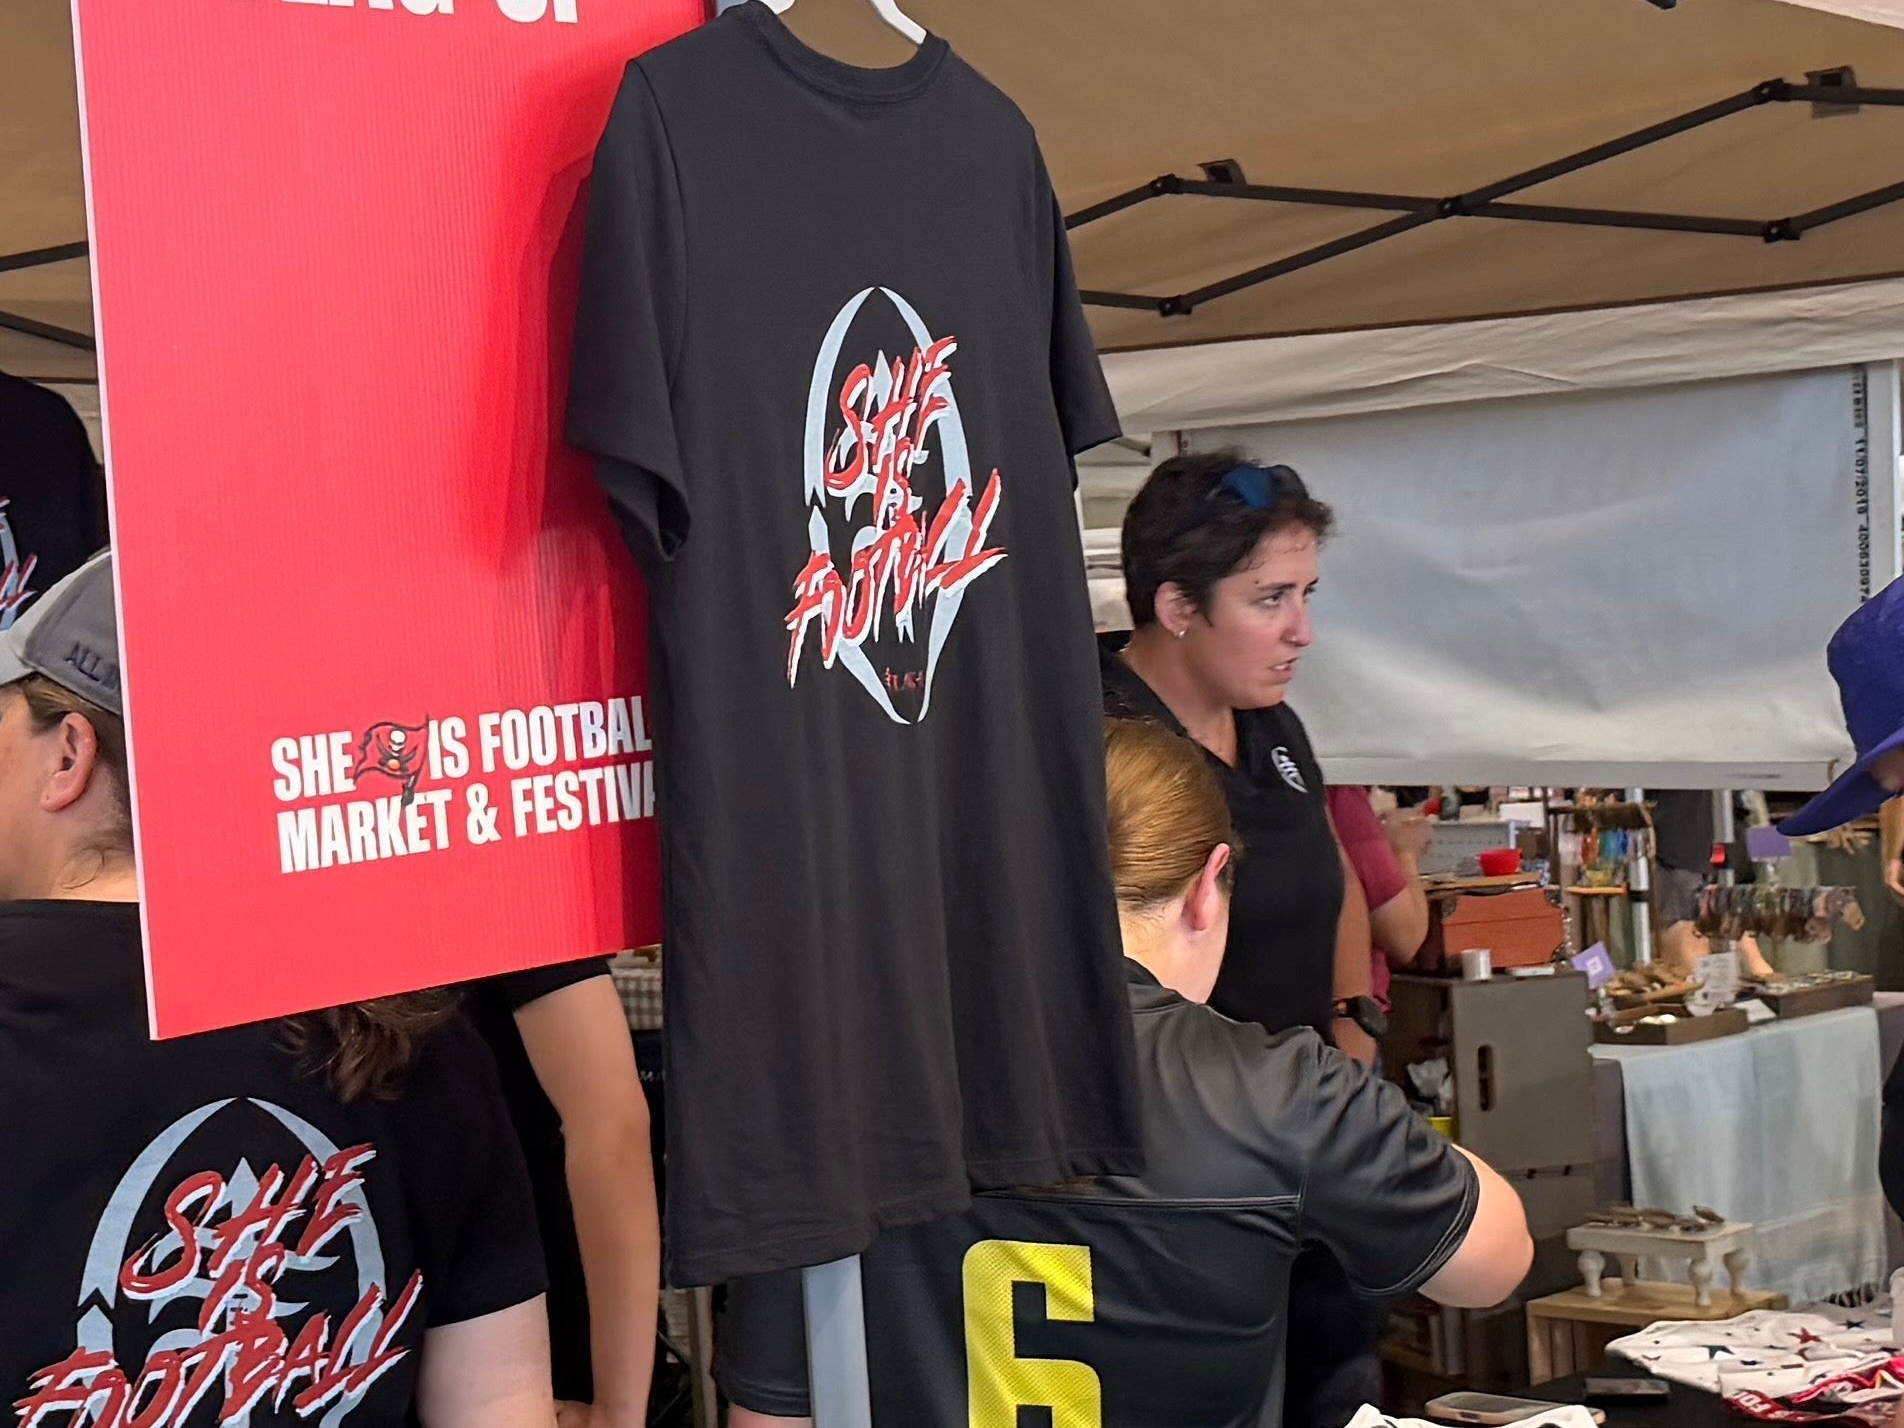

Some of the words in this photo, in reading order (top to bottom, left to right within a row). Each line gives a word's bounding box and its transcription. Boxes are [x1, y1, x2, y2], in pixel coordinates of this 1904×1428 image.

[825, 335, 958, 498] SHE
[271, 730, 356, 802] SHE
[428, 716, 470, 780] IS
[479, 695, 653, 773] FOOTBAL
[276, 788, 453, 874] MARKET
[466, 783, 502, 845] &
[119, 1142, 378, 1301] SHE
[198, 1241, 288, 1338] IS
